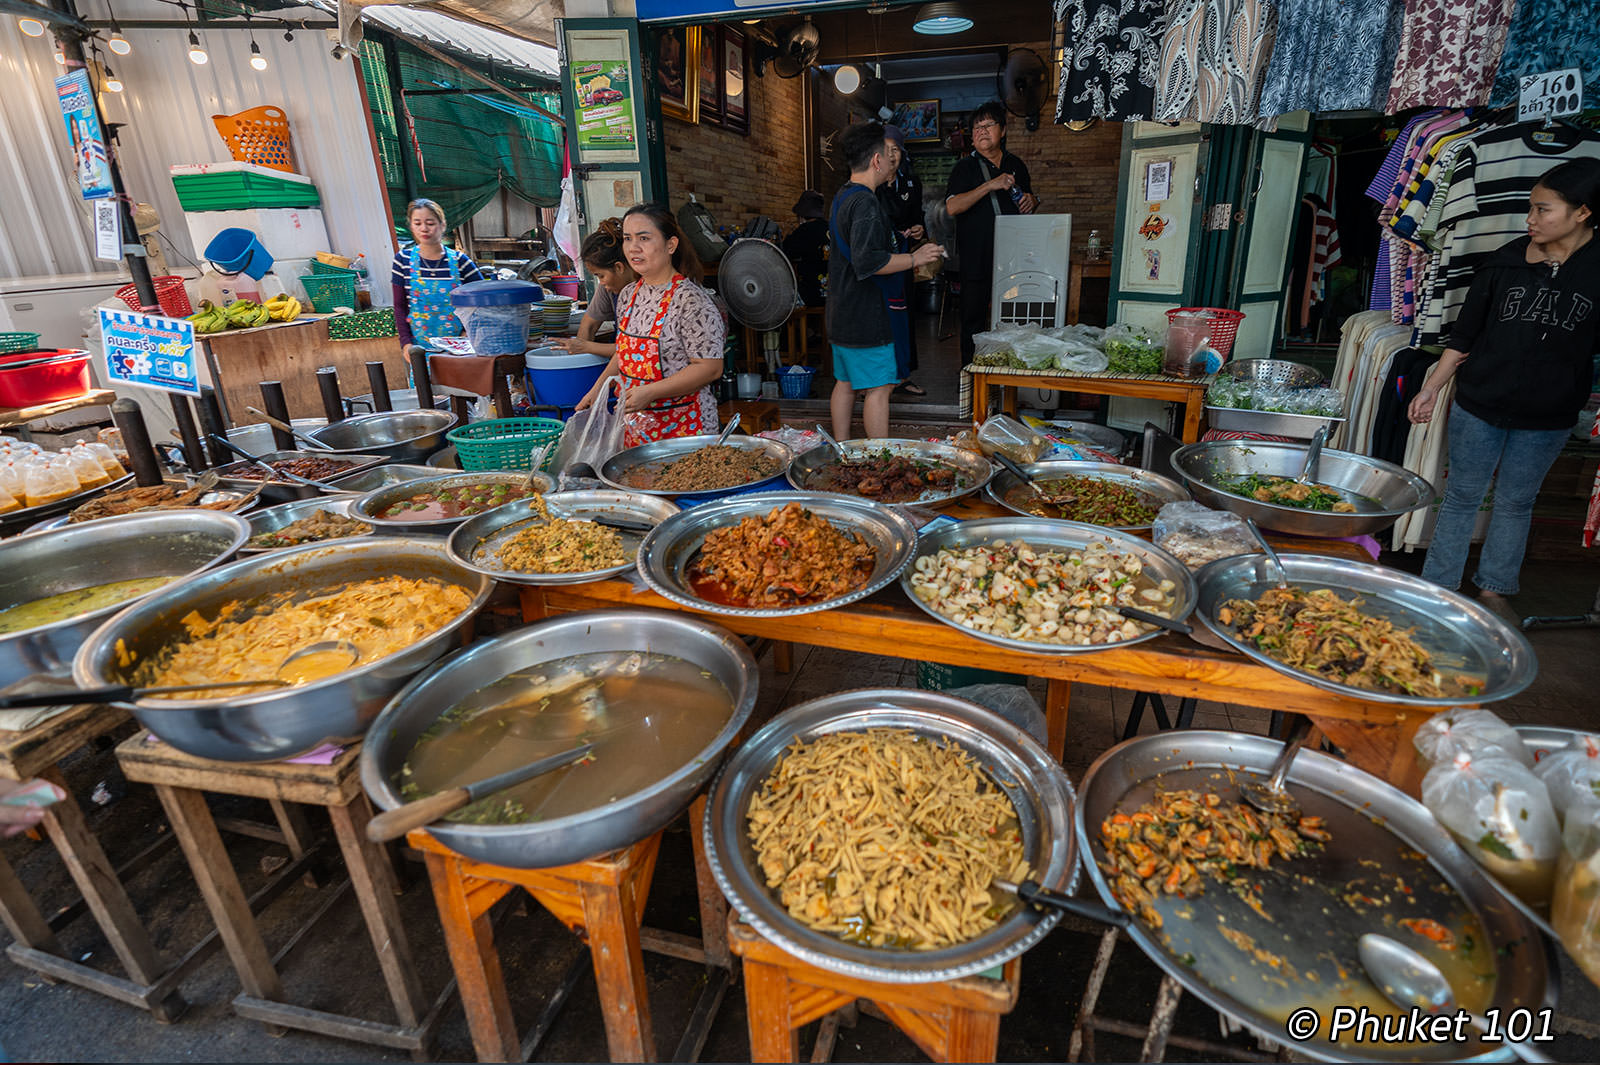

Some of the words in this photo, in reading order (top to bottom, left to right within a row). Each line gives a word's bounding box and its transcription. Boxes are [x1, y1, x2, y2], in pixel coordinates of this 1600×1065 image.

[1540, 74, 1575, 97] 160
[1544, 93, 1579, 114] 300
[1499, 286, 1593, 331] GAP
[107, 335, 156, 352] คนละครึ่ง
[159, 340, 193, 356] พลัส
